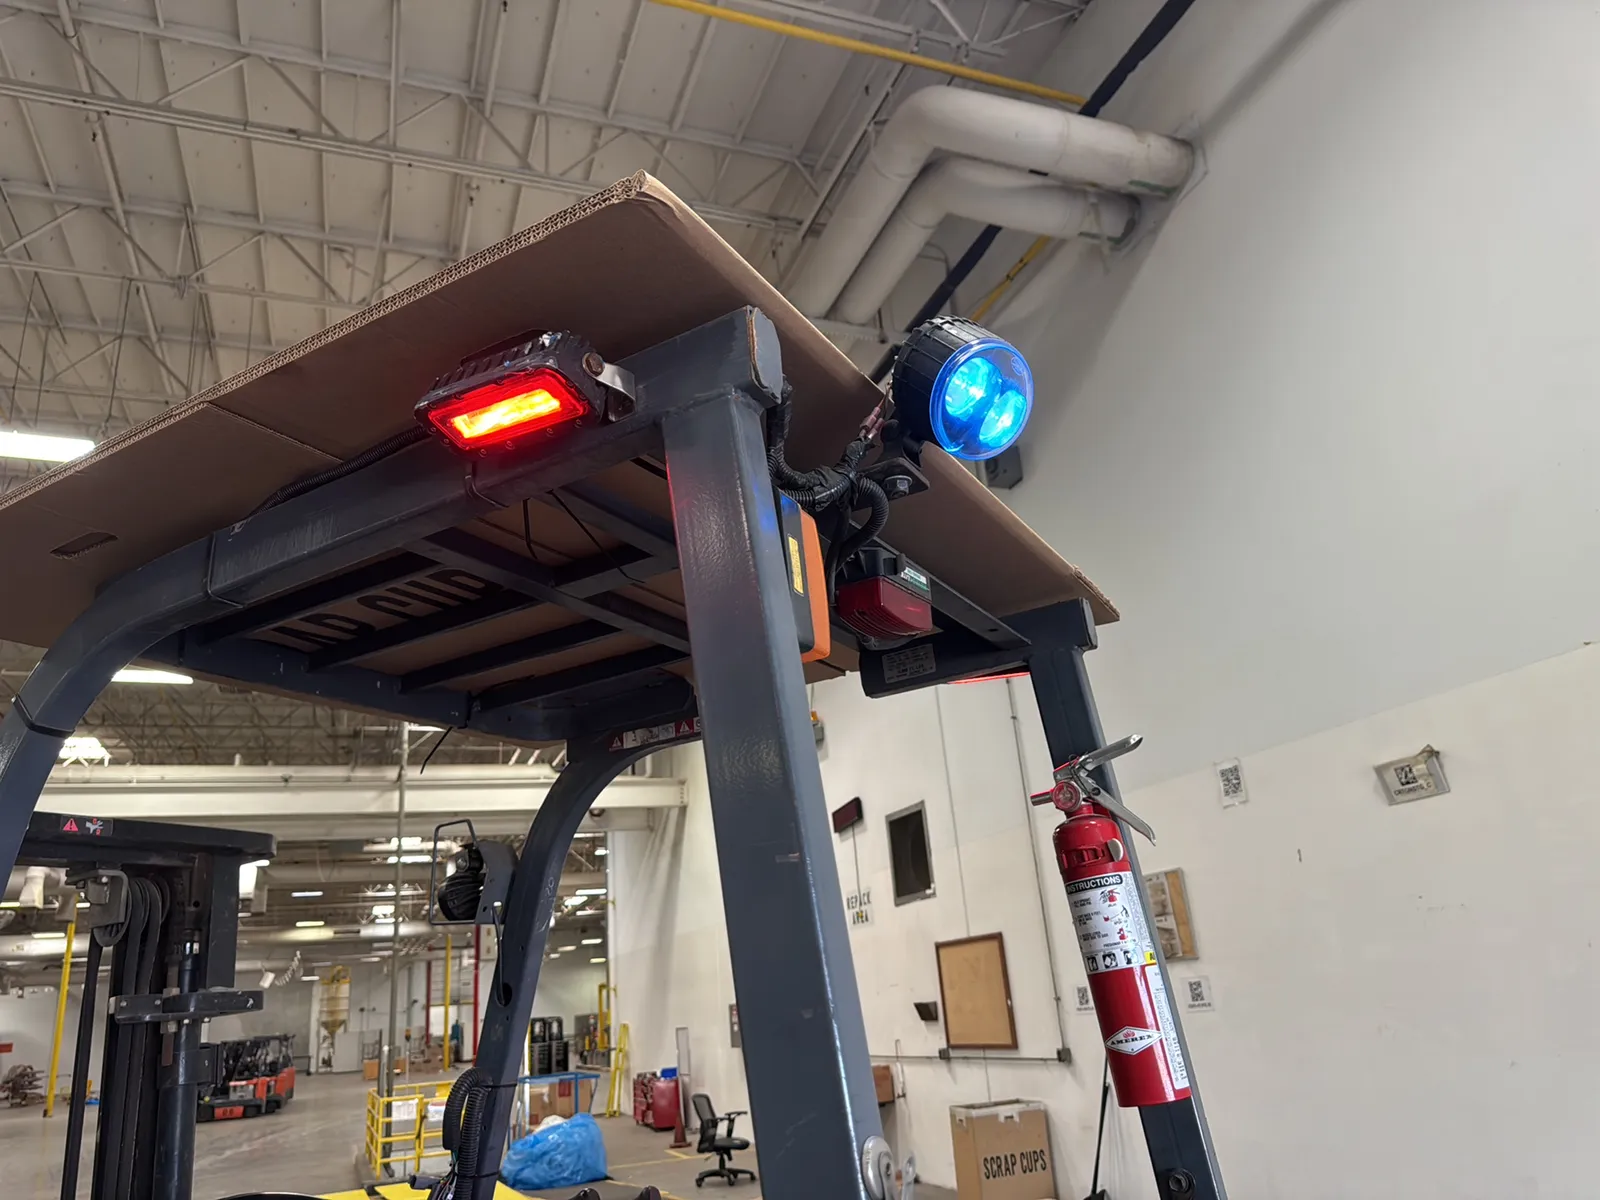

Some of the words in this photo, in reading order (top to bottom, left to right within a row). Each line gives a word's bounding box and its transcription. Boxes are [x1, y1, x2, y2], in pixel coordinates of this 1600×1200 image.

[1110, 1033, 1153, 1046] AMEREX
[983, 1153, 1017, 1180] SCRAP
[1020, 1148, 1047, 1174] CUPS
